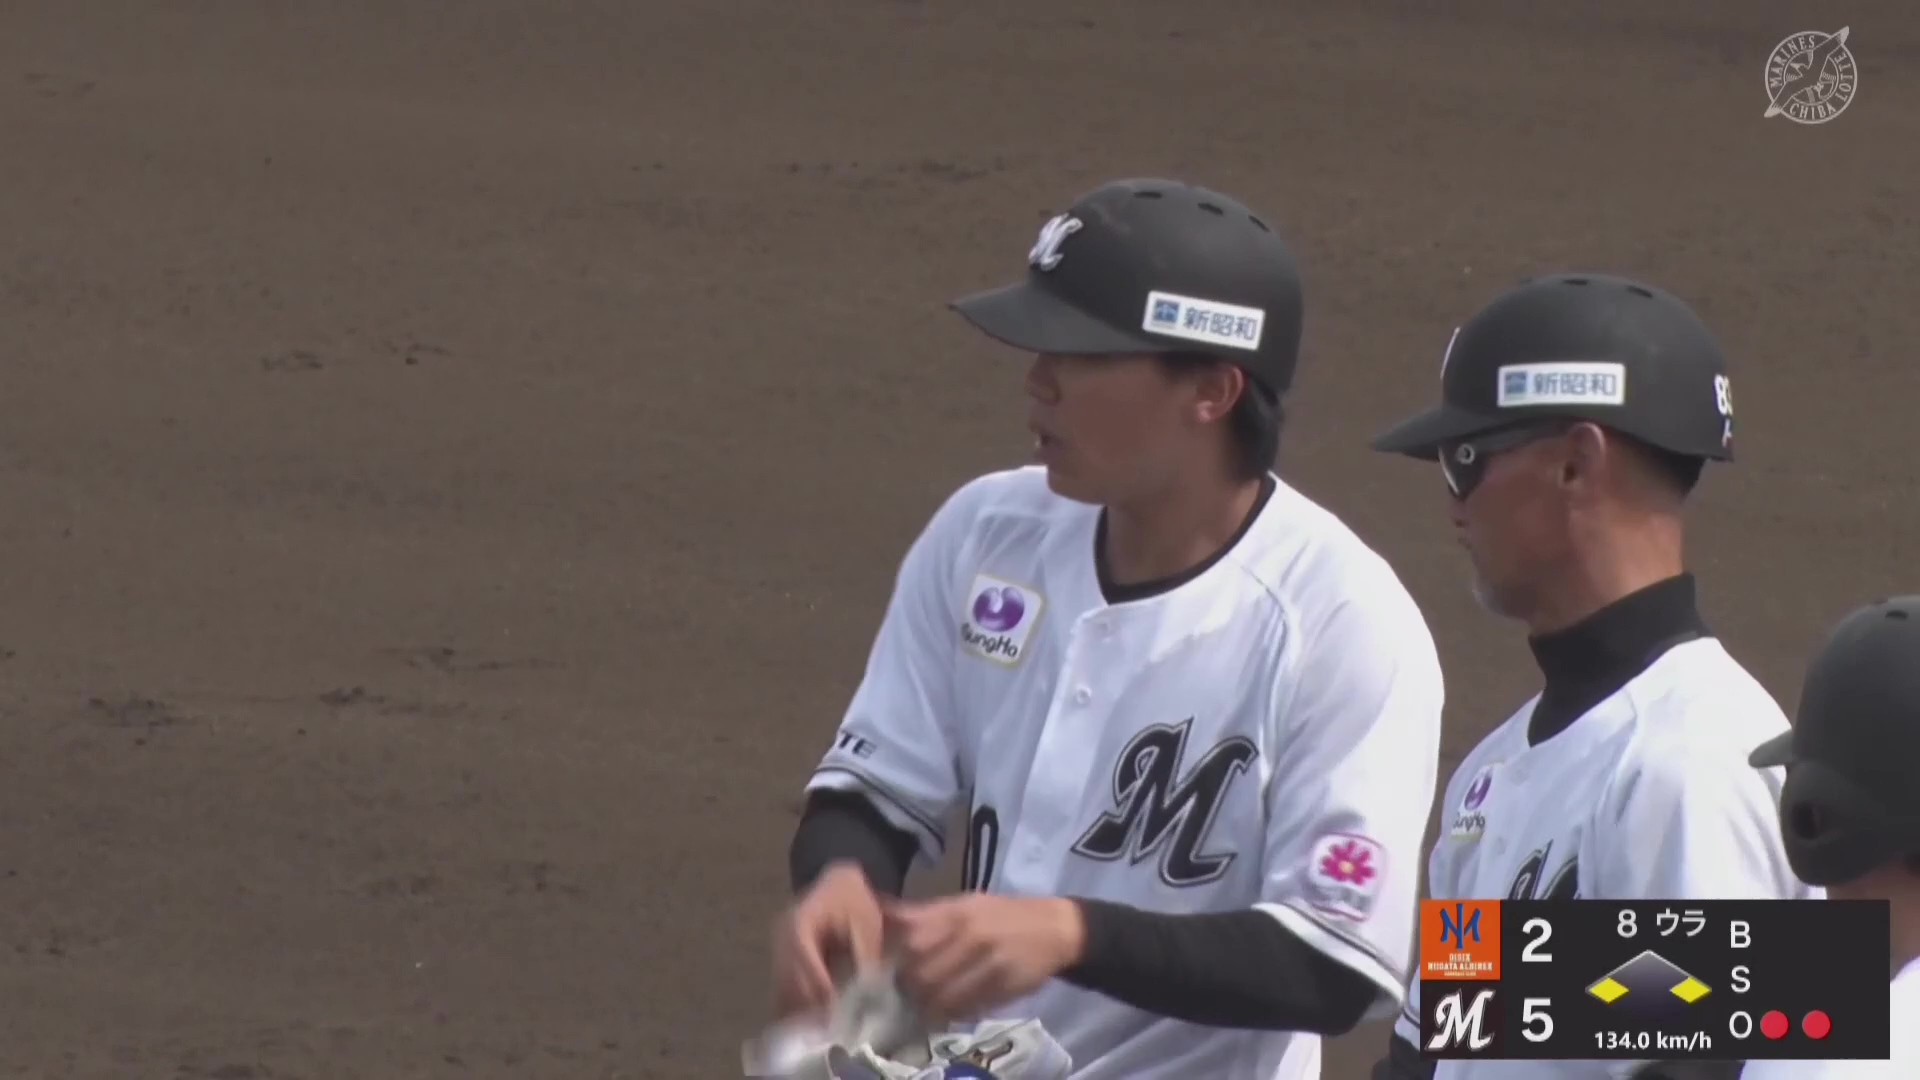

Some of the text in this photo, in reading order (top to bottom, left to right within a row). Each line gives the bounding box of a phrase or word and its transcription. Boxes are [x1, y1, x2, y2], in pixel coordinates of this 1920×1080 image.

[1182, 305, 1258, 342] 新昭和
[1534, 372, 1617, 397] 新昭和
[1070, 716, 1259, 888] M
